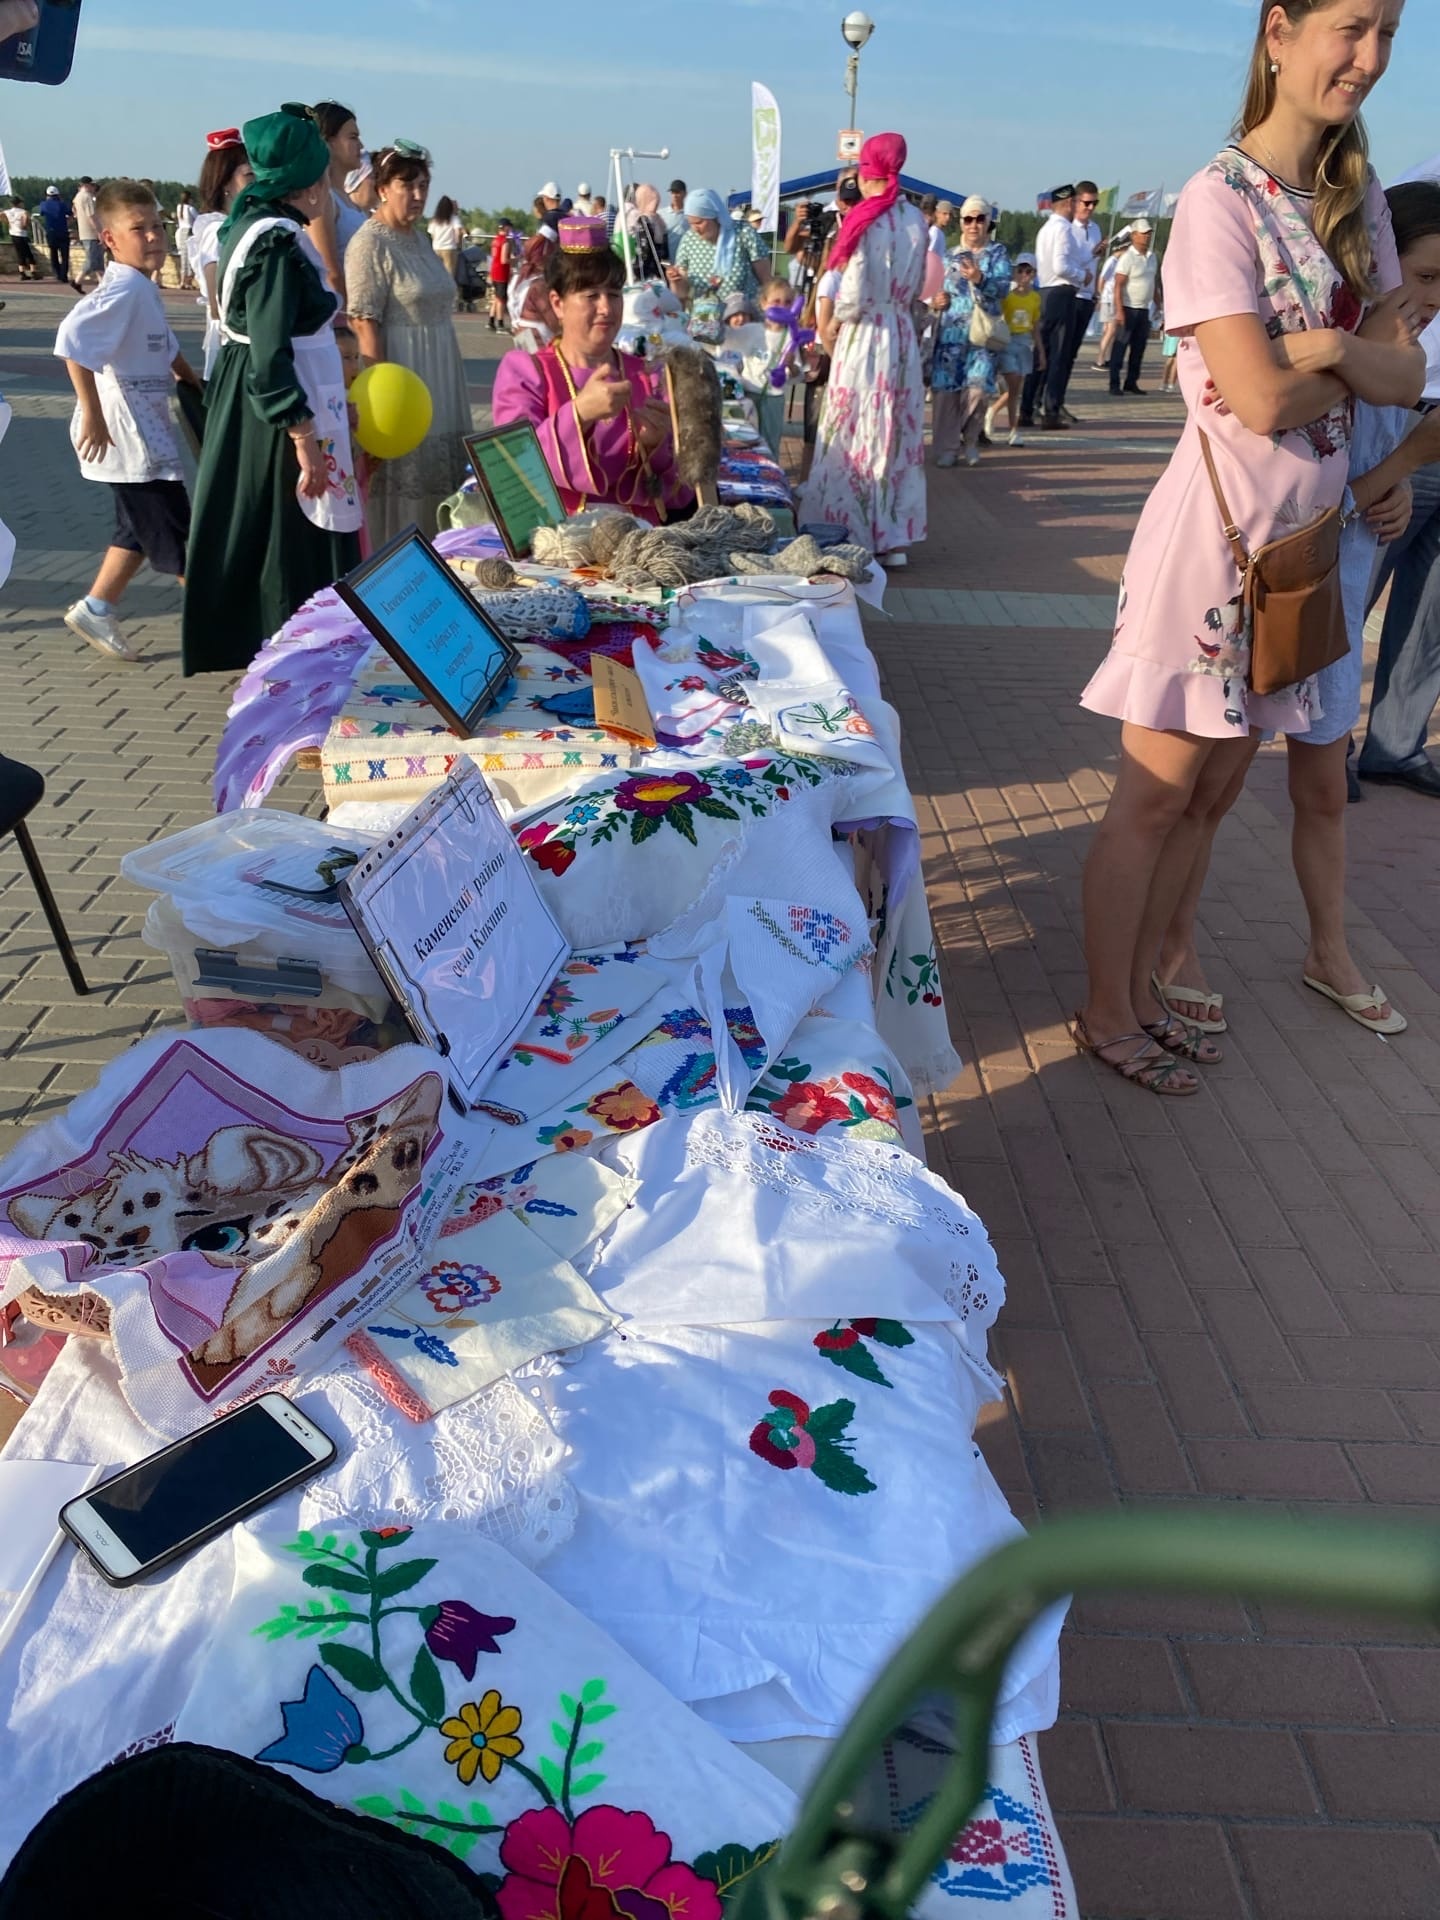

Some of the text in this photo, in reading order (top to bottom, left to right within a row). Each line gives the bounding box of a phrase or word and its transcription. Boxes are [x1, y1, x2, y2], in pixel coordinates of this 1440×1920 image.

[413, 852, 505, 963] Каменский район
[452, 901, 508, 978] село Кикино
